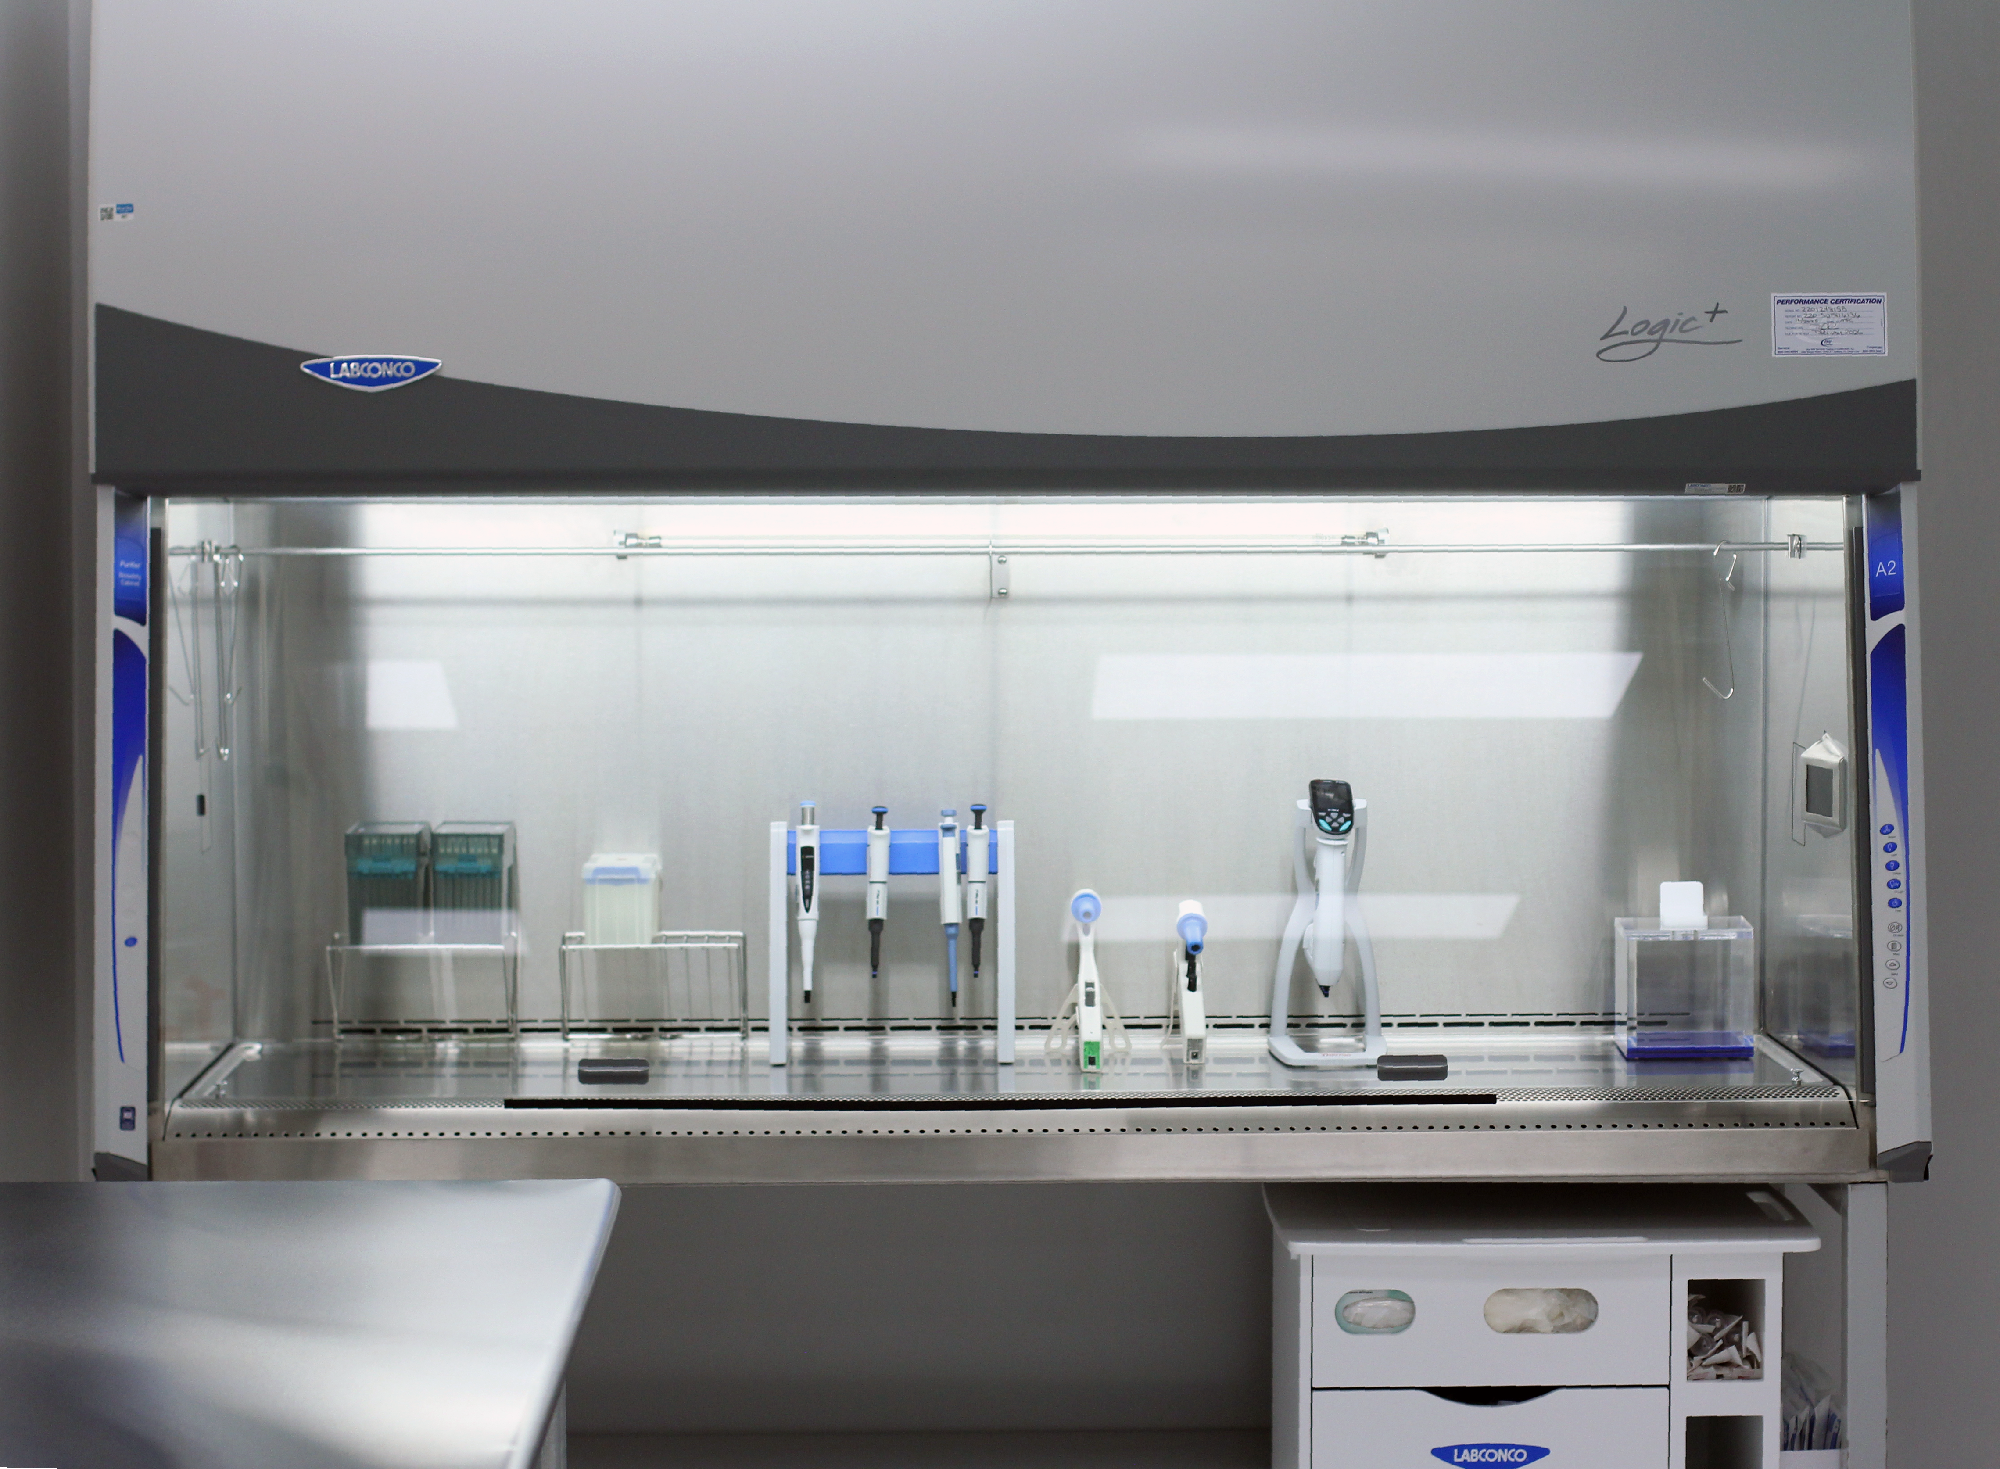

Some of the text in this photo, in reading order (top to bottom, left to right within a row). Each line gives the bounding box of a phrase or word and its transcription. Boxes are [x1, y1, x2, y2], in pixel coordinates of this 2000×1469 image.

[329, 361, 416, 379] LABCONCO
[1875, 560, 1897, 578] A2
[1453, 1448, 1528, 1463] LABCONCO
